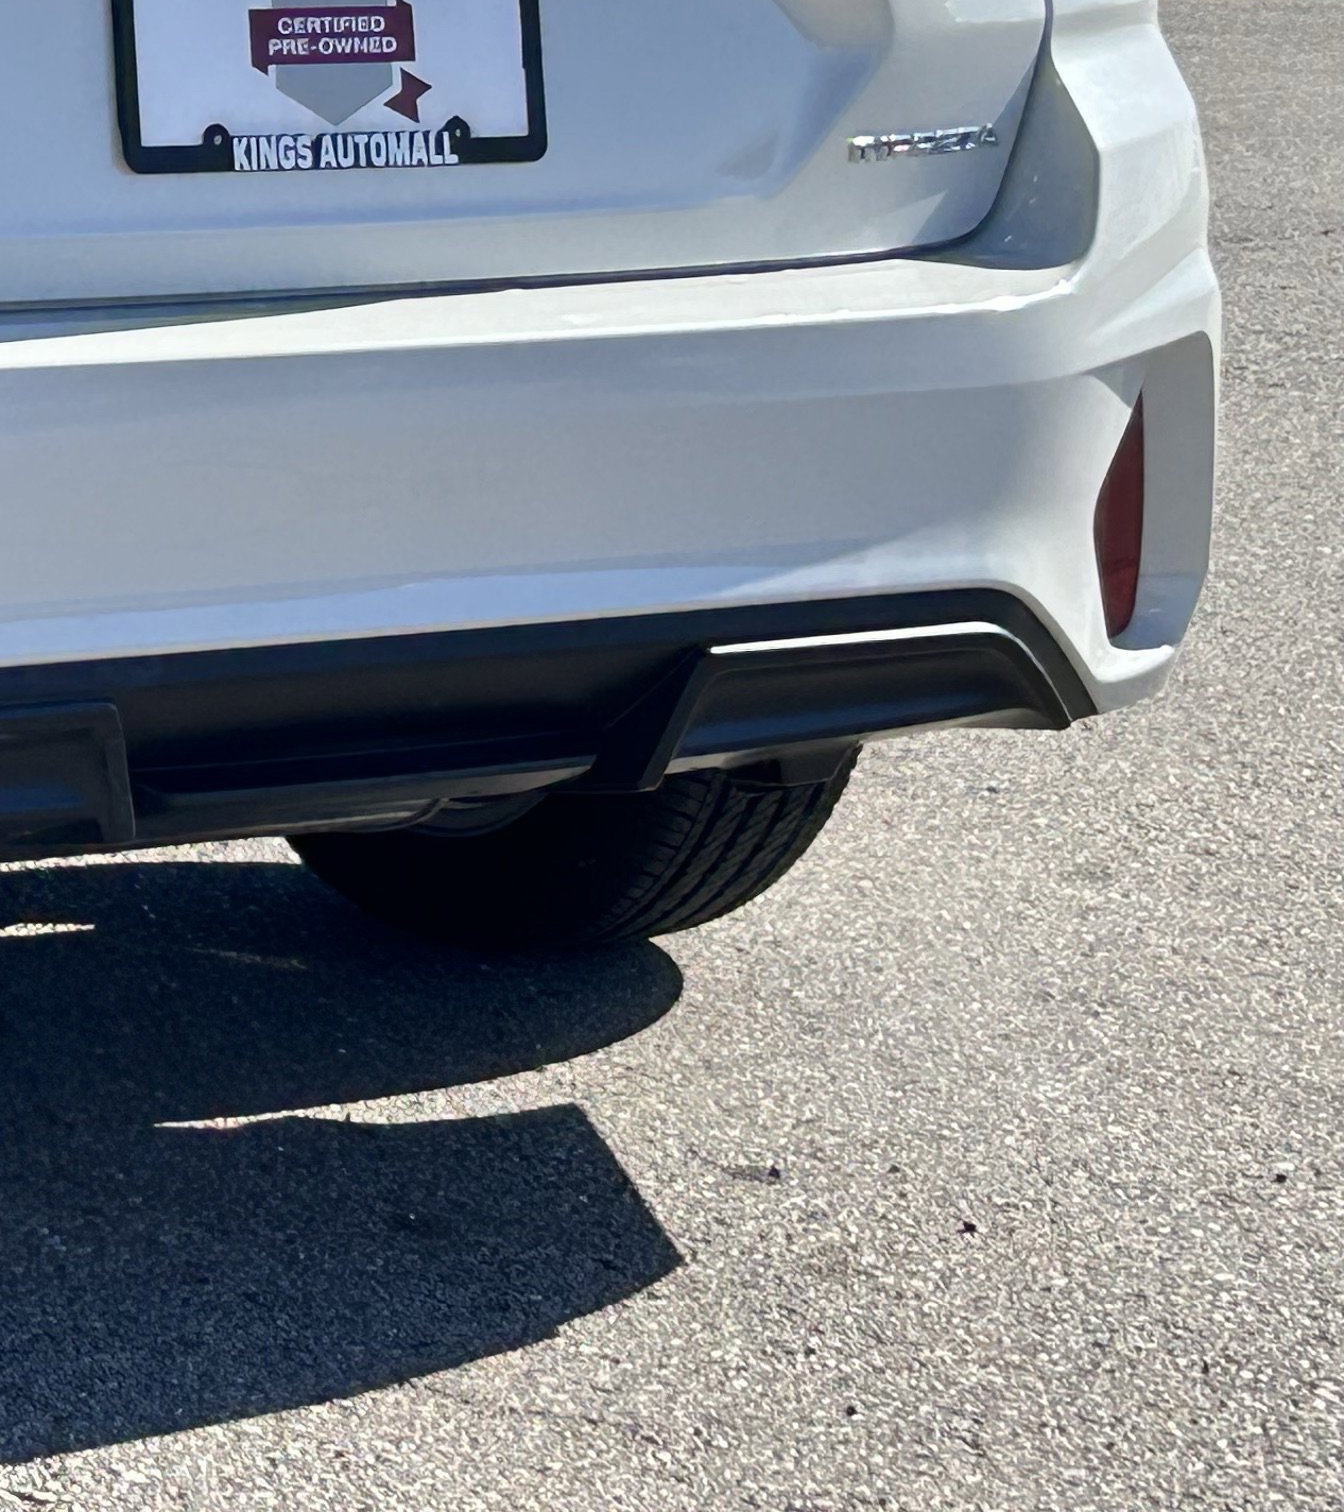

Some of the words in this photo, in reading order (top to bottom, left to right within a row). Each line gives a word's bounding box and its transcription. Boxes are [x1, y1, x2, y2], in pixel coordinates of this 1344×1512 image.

[277, 15, 386, 35] CERTIFIED
[267, 36, 398, 56] PRE-OWNED
[232, 134, 313, 171] KINGS
[319, 130, 459, 168] AUTOMALL
